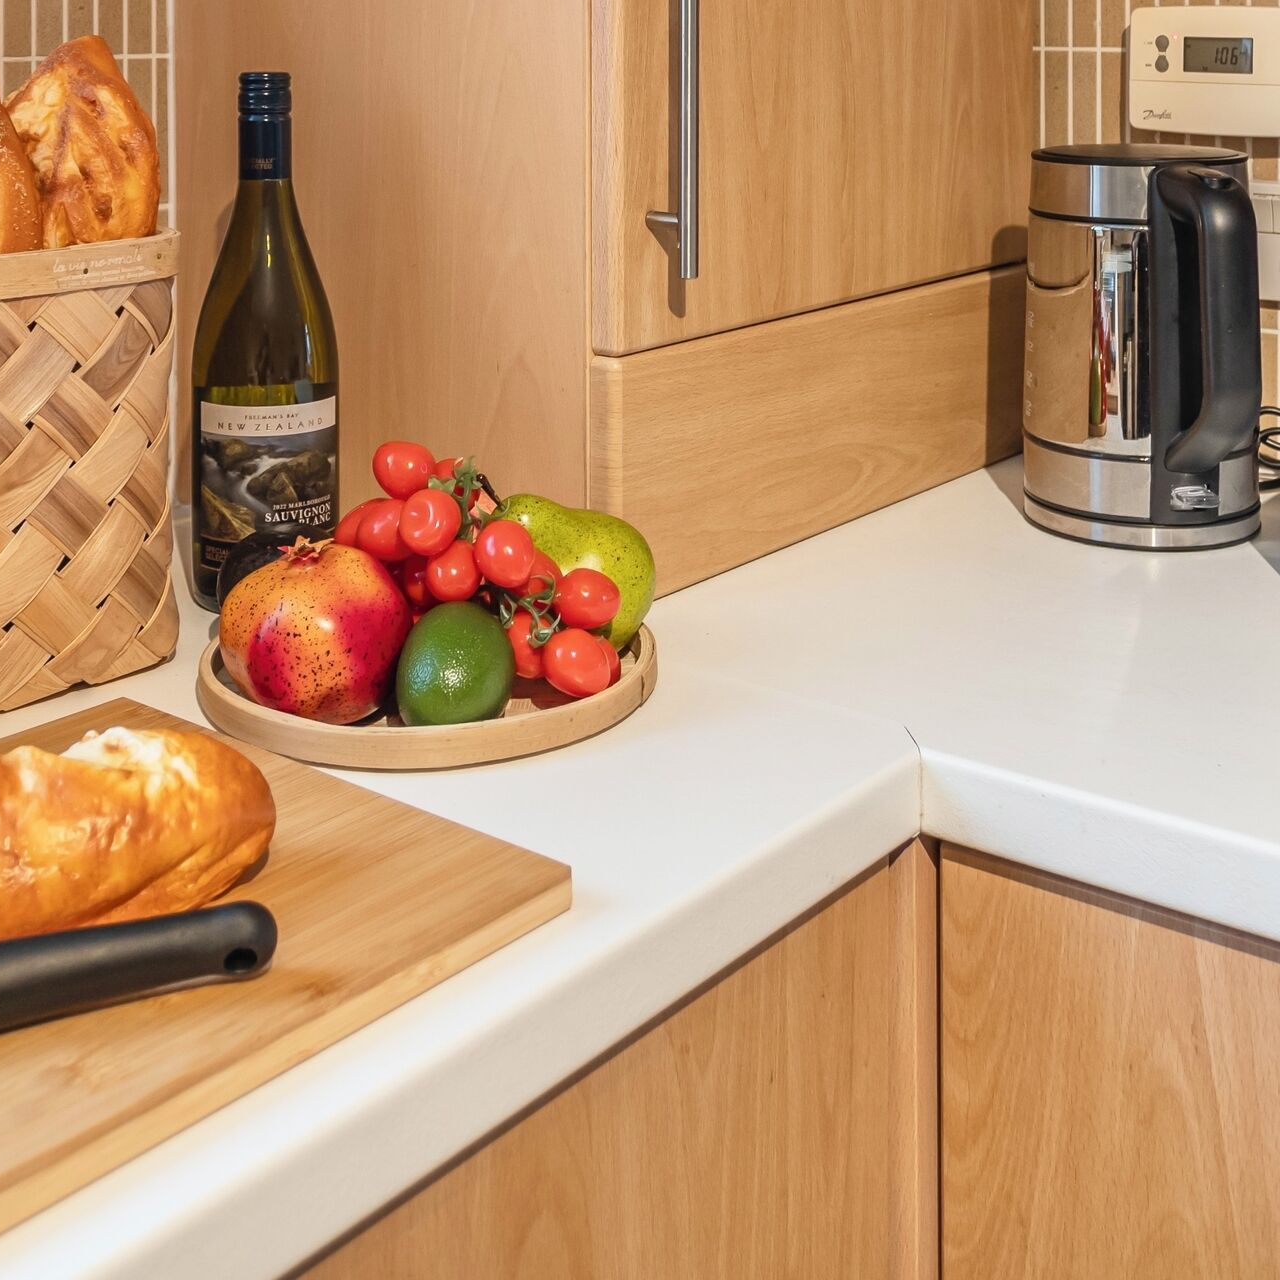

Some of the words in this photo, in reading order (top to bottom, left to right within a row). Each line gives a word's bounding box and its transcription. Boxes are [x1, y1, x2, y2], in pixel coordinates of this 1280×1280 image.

[217, 422, 246, 431] NEW
[254, 417, 323, 431] ZEALAND
[264, 502, 331, 522] SAUVIGNON
